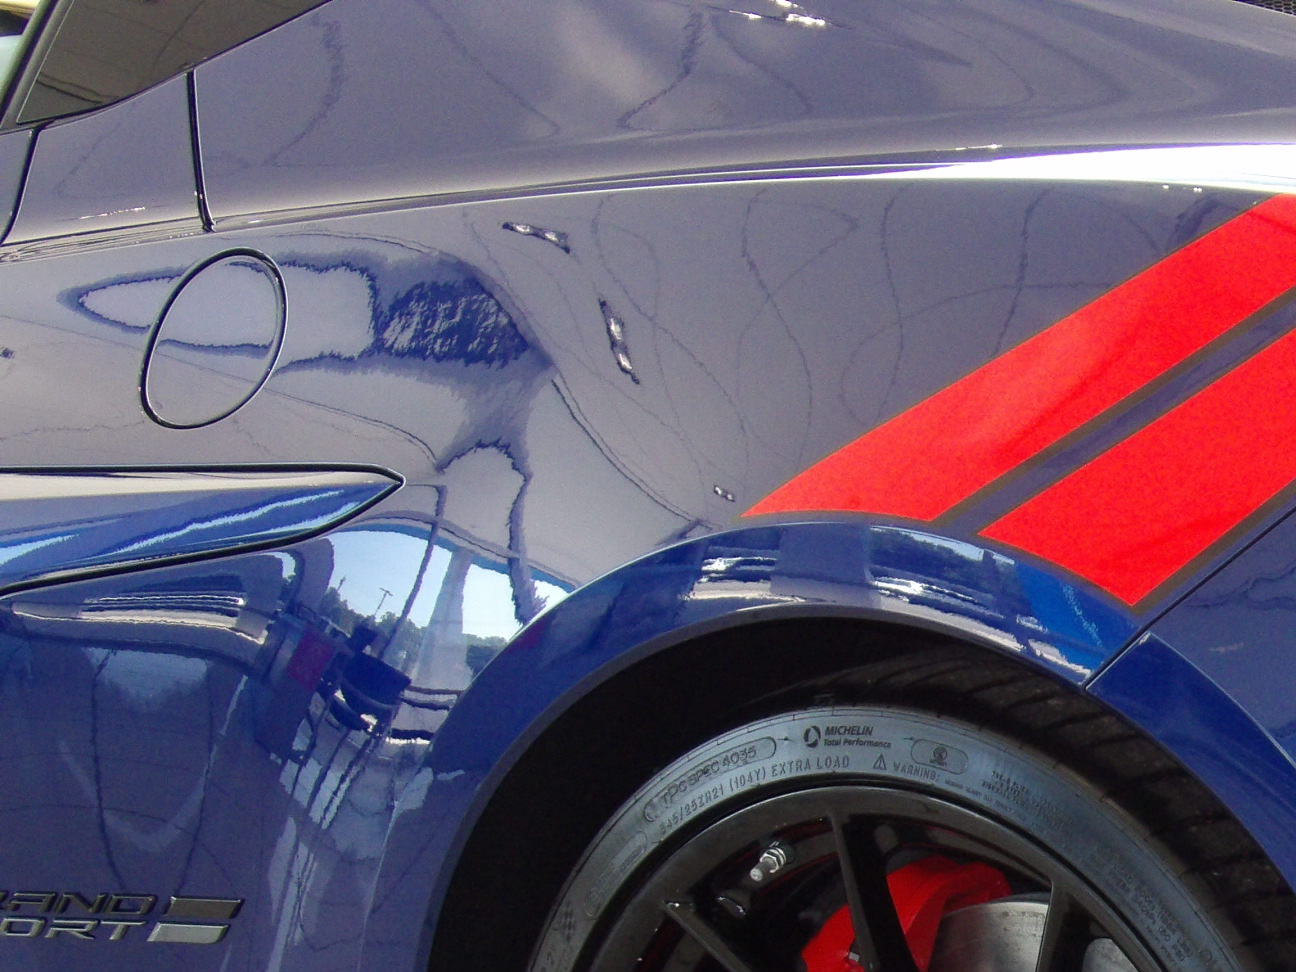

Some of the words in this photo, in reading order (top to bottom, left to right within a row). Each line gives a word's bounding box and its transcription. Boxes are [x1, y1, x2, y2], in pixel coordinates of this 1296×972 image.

[825, 726, 874, 737] MICHELIN
[824, 738, 842, 747] Total
[843, 739, 892, 749] Performance
[772, 757, 811, 777] EXTRA
[816, 755, 850, 770] LOAD
[0, 891, 156, 915] AND
[0, 917, 146, 941] ORT
